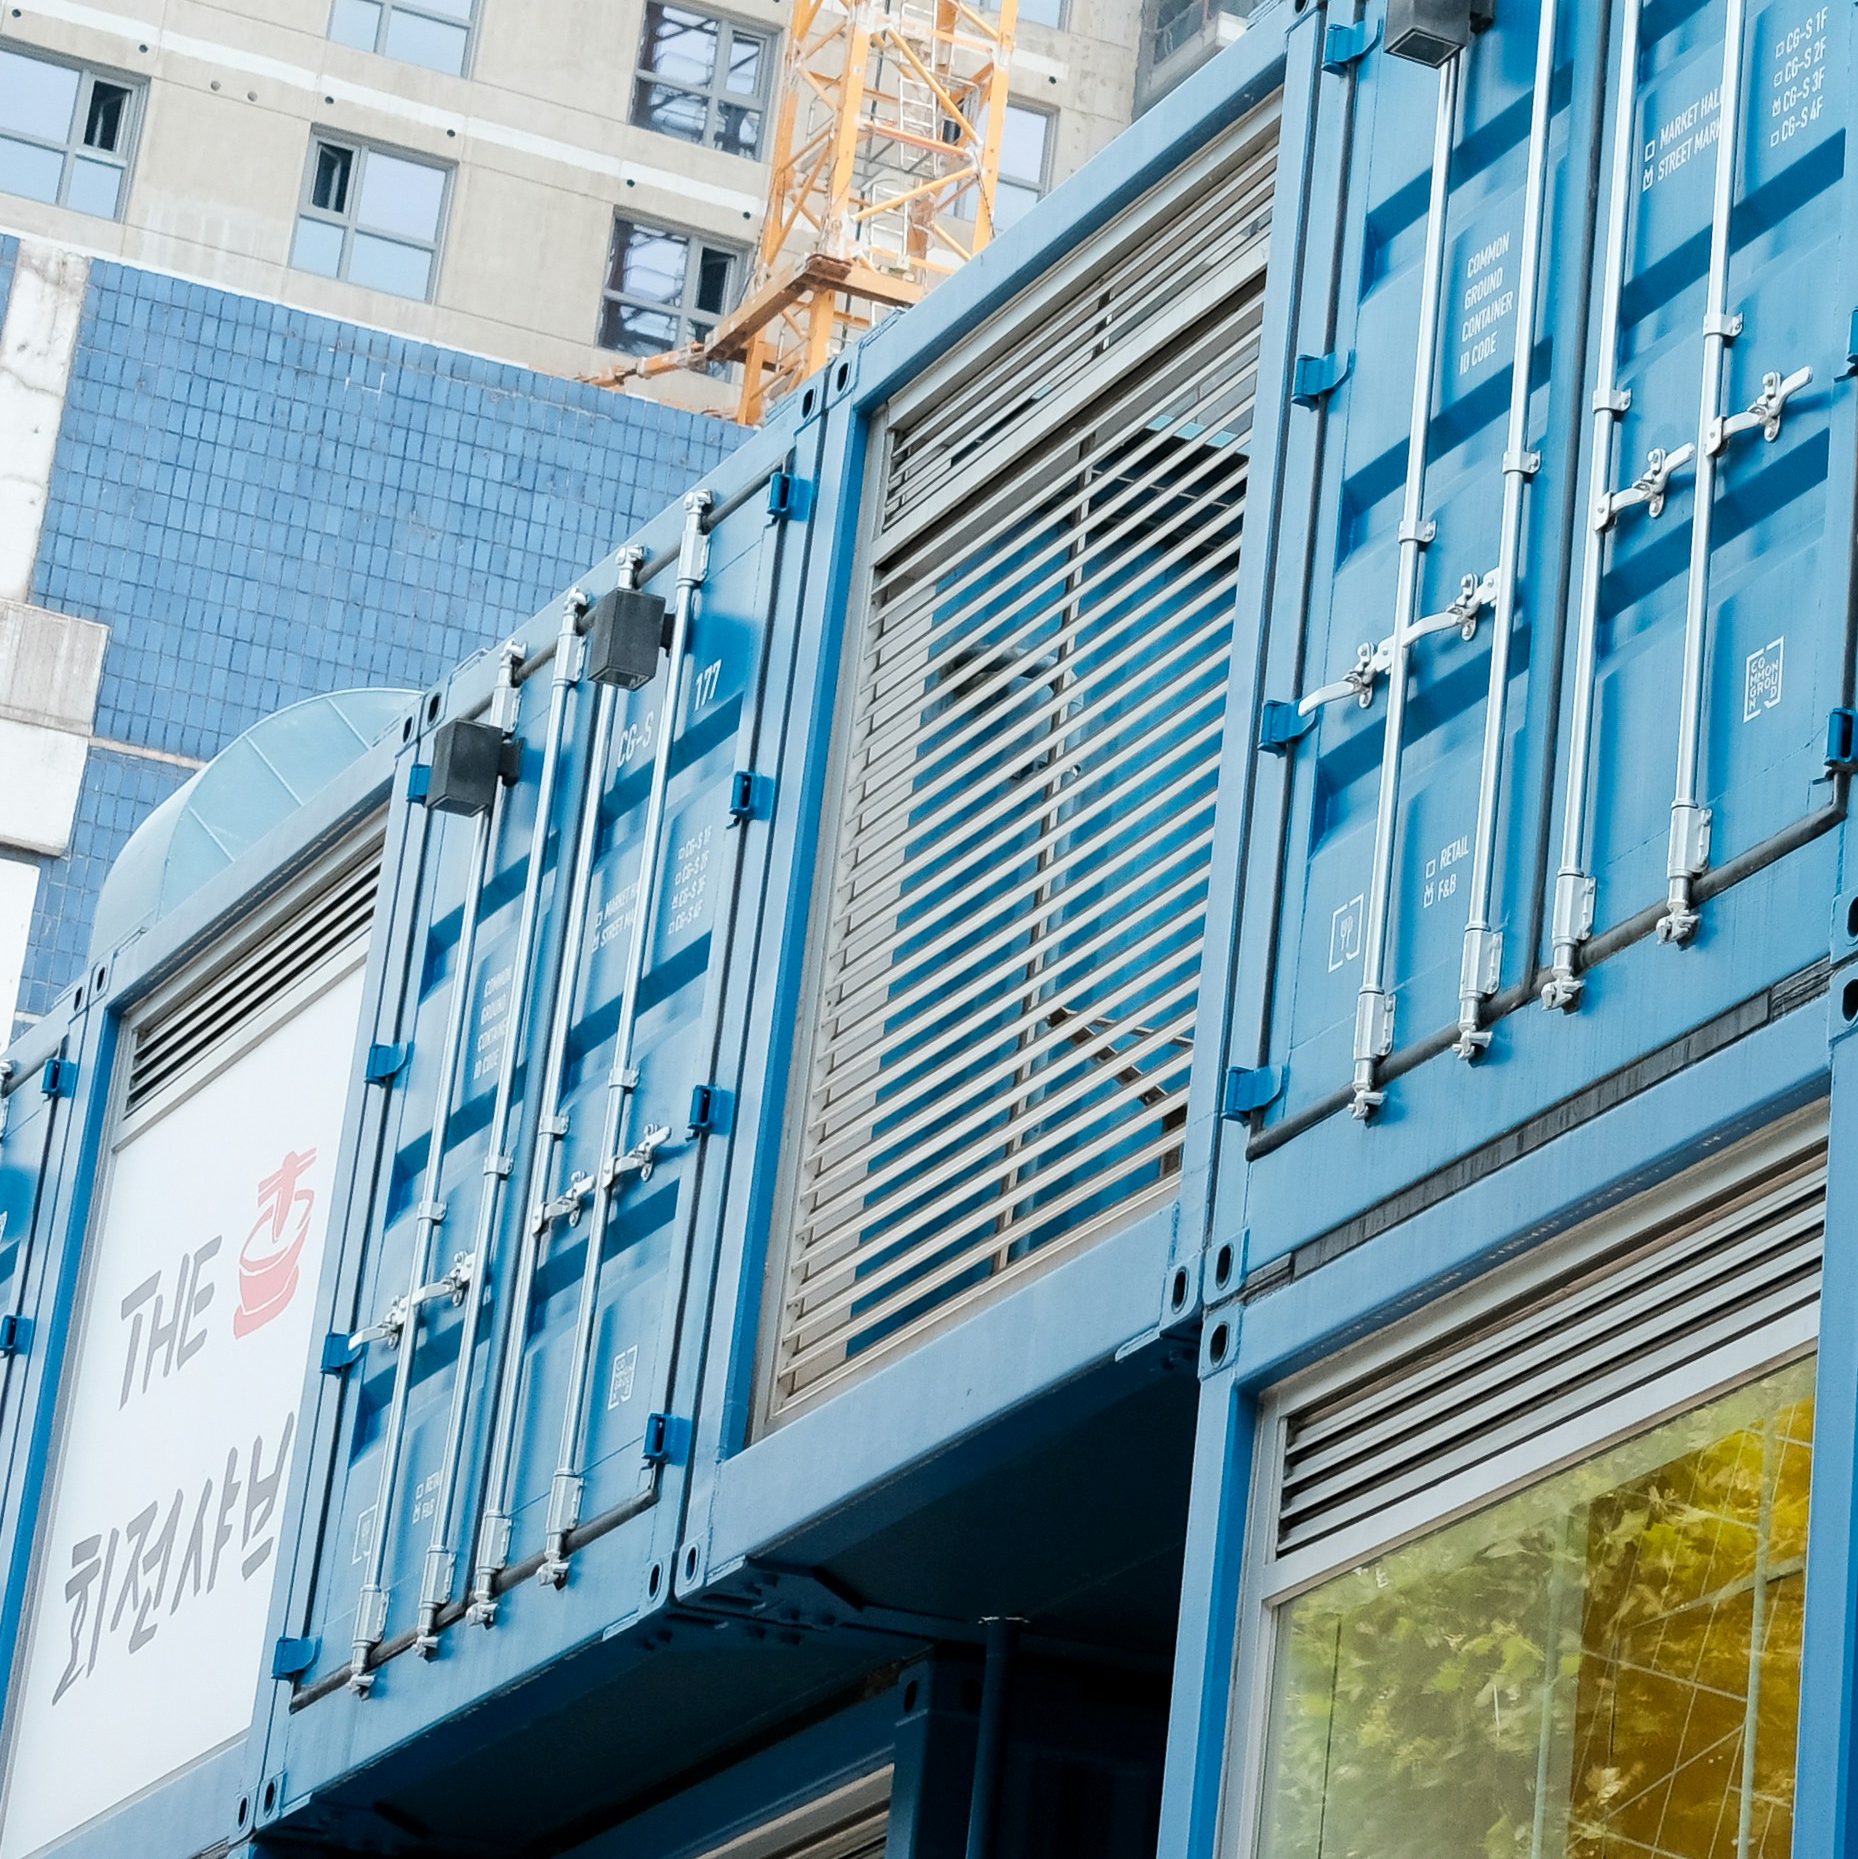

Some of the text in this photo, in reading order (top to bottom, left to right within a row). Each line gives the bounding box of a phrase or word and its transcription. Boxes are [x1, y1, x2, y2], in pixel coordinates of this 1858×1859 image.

[1660, 87, 1722, 151] MARKET HAL
[1657, 136, 1694, 182] STREET
[1467, 231, 1511, 279] COMMON
[1464, 266, 1504, 311] GROUND
[1461, 290, 1514, 343] CONTAINER
[1459, 331, 1498, 376] ID CODE
[695, 659, 722, 712] 177
[1439, 834, 1470, 871] RETAIL
[1437, 873, 1457, 902] F&B
[119, 1234, 223, 1411] THE
